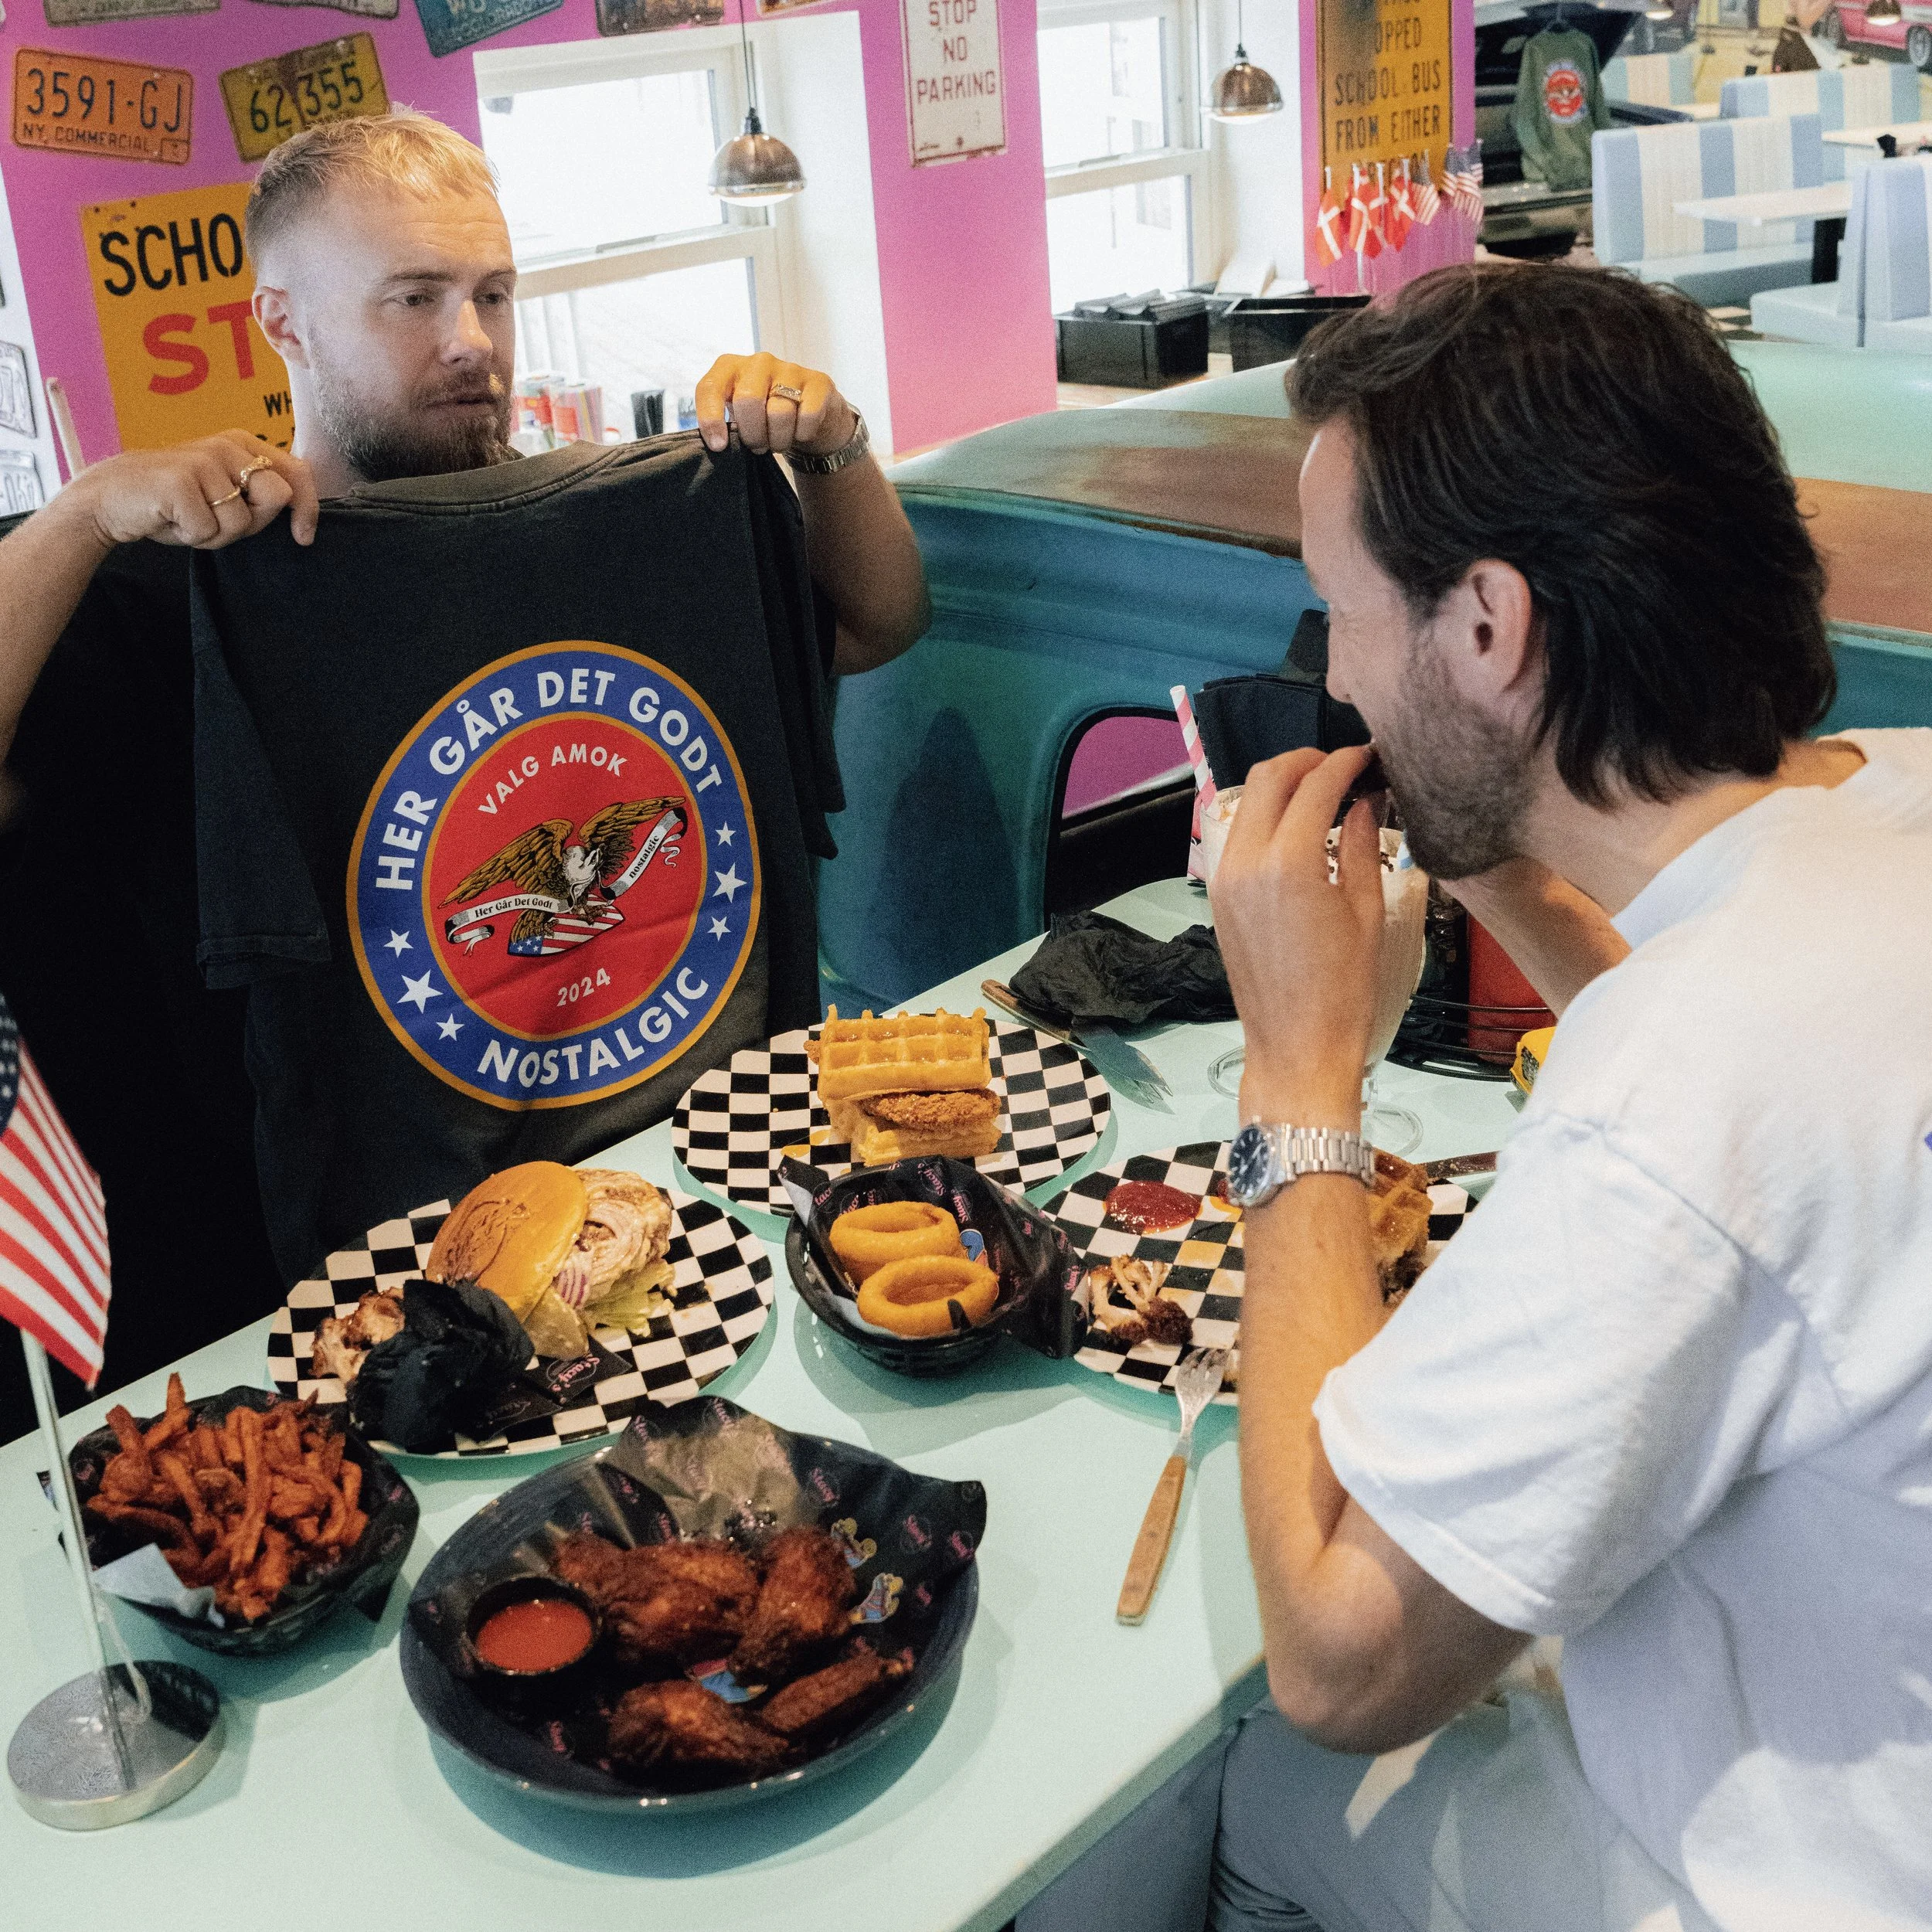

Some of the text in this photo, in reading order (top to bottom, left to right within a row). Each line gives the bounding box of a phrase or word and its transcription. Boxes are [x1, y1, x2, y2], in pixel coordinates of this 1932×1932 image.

[929, 0, 977, 26] STOP
[942, 36, 968, 63] NO
[1374, 16, 1422, 53] OPPED
[917, 70, 995, 105] PARKING
[1335, 59, 1441, 106] SCHOOL BUS
[55, 126, 151, 153] COMMERCIAL
[1335, 104, 1440, 153] FROM EITHER
[100, 213, 243, 297] SCHO
[142, 300, 256, 396] ST
[376, 667, 723, 891] HER GÅR DET GODT
[478, 743, 628, 815] VALG AMOK
[628, 835, 660, 879] nostalgic
[474, 897, 553, 918] Her Går Det Godt
[556, 968, 612, 1007] 2024
[477, 967, 710, 1088] NOSTALGIC
[917, 1162, 947, 1197] Stacy's
